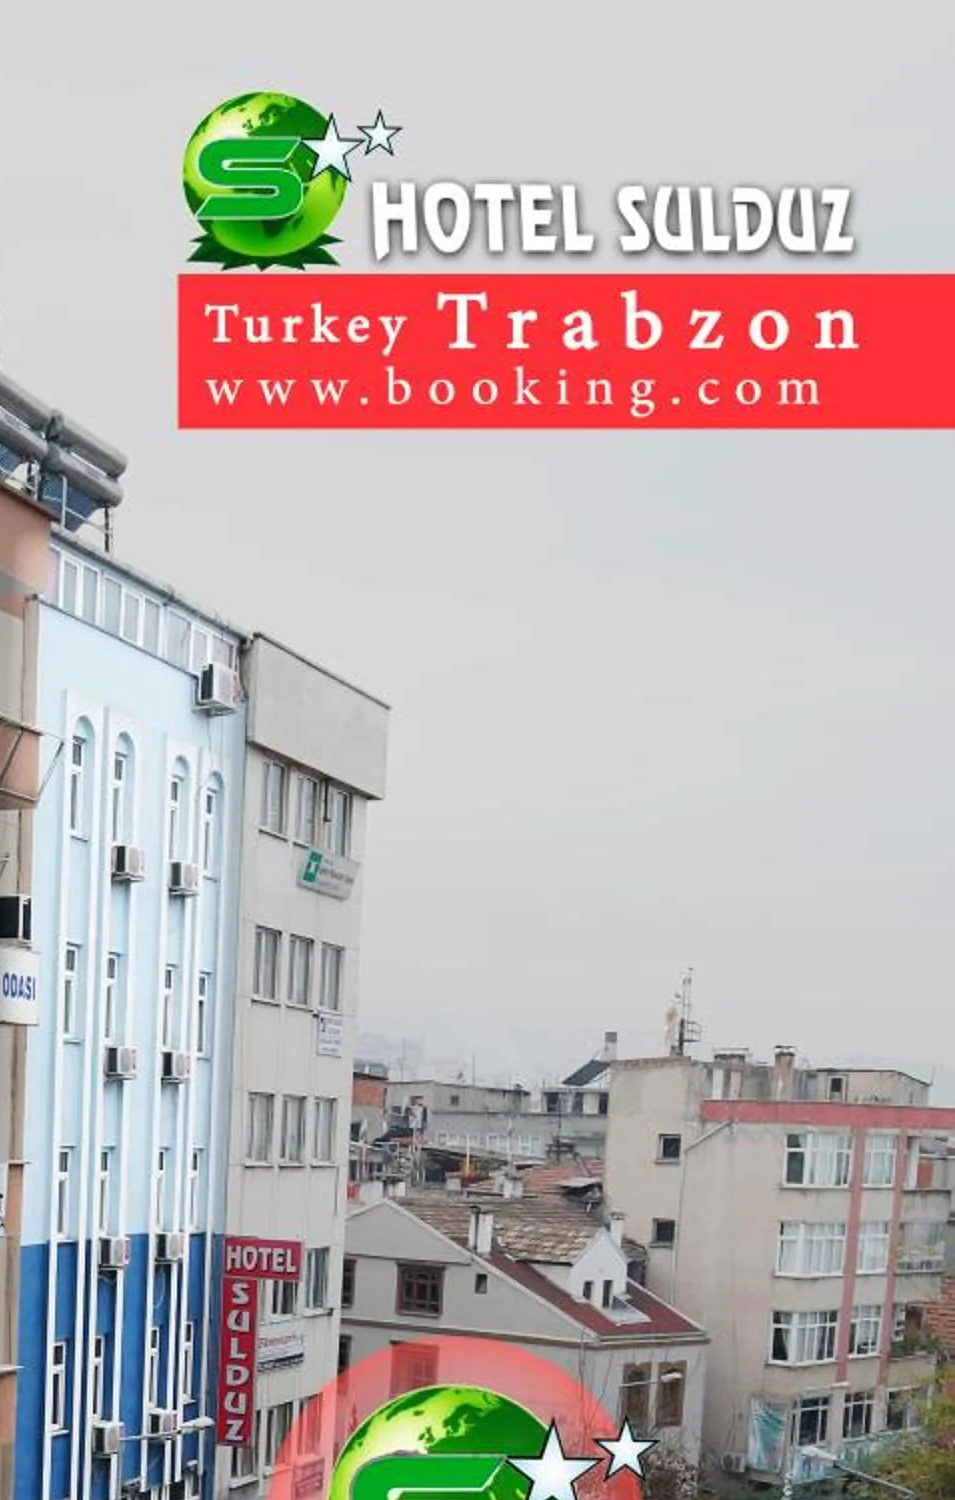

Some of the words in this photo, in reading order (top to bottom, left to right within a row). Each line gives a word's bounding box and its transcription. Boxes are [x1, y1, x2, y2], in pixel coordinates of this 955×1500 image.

[2, 972, 37, 1001] ODASI
[226, 1245, 297, 1273] HOTEL
[223, 1283, 251, 1441] SULDUZ
